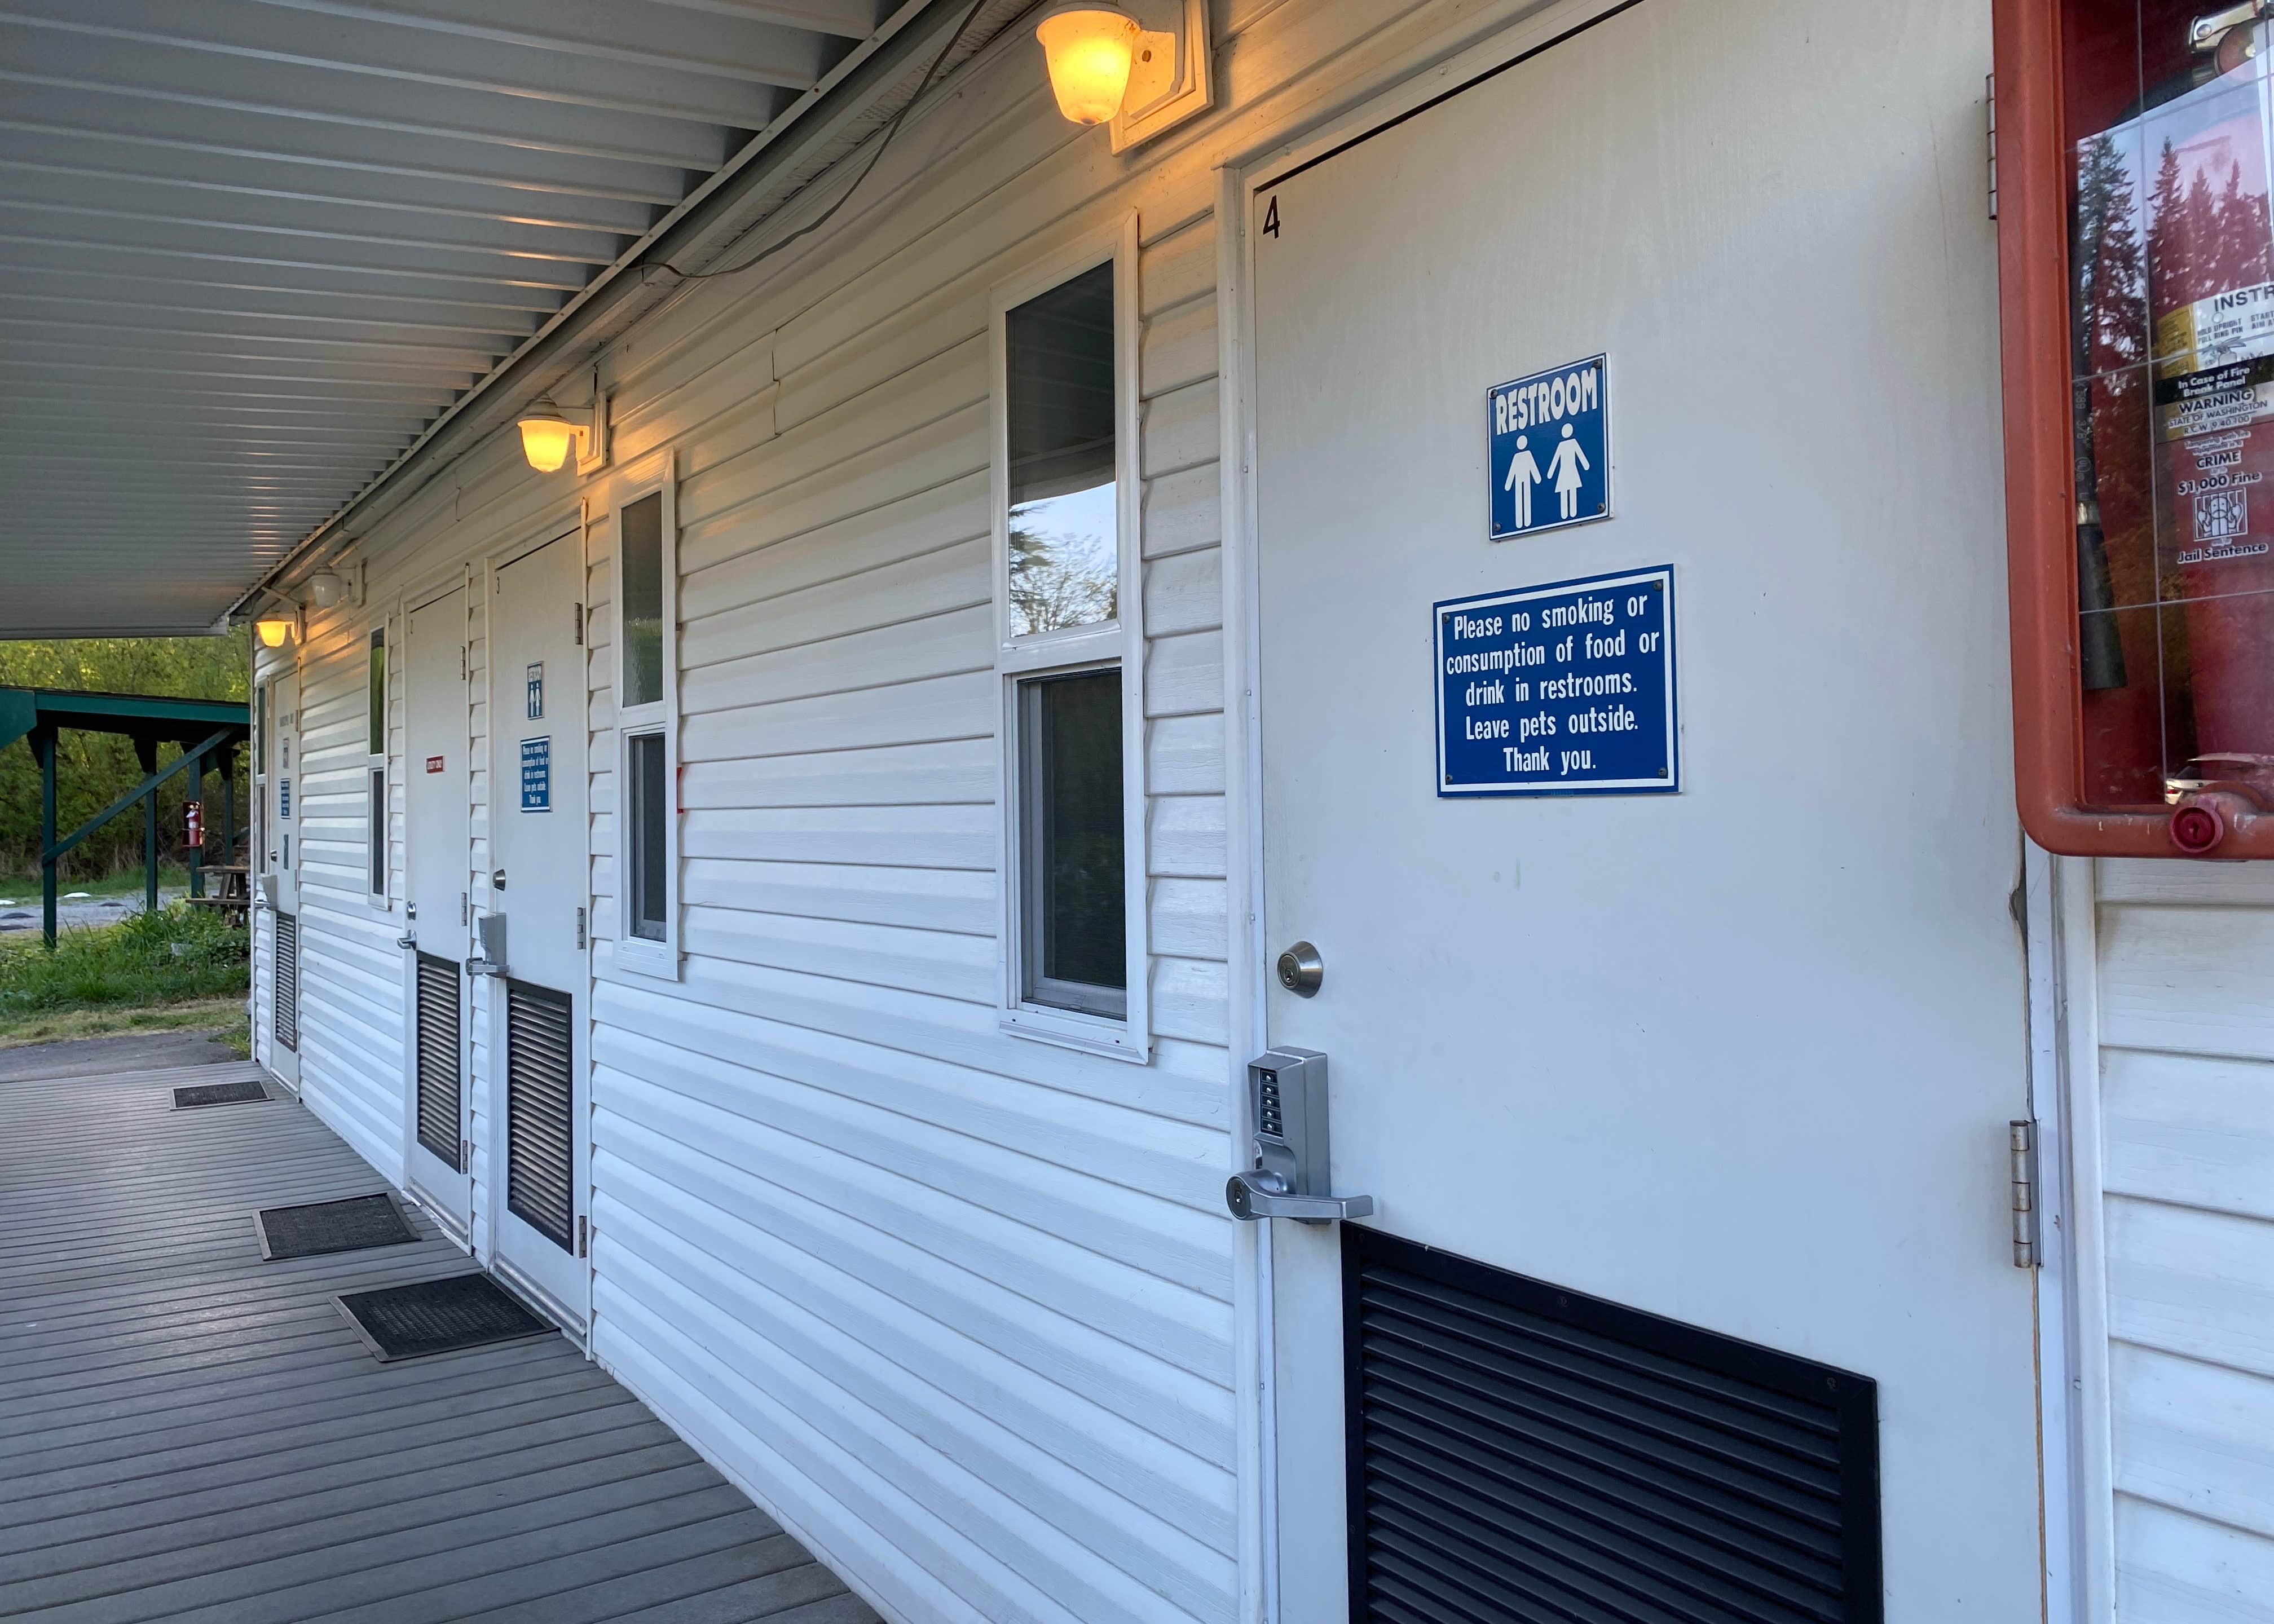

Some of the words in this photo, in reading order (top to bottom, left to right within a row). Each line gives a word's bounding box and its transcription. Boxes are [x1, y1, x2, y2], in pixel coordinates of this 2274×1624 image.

[1263, 195, 1280, 239] 4
[2214, 285, 2274, 311] INSTR
[2232, 326, 2243, 334] PIN
[2178, 381, 2188, 389] In
[2190, 375, 2215, 386] Case
[2217, 370, 2228, 380] of
[2231, 367, 2250, 377] Fire
[2183, 385, 2214, 397] Break
[2216, 376, 2246, 390] Panel
[1496, 367, 1597, 435] RESTROOM
[2170, 416, 2192, 427] STATE
[2206, 400, 2268, 419] WASHINGTON
[2179, 388, 2254, 414] WARNING
[2197, 451, 2240, 468] CRIME
[2179, 475, 2227, 493] $1,000
[2232, 472, 2260, 484] Fine
[2179, 550, 2200, 562] Jail
[2205, 544, 2266, 558] Sentence
[1455, 615, 1502, 640] Please
[1512, 612, 1530, 632] no
[1542, 596, 1614, 628] smoking
[1627, 595, 1647, 617] or
[1447, 642, 1545, 675] consumption
[1556, 636, 1574, 663] of
[1585, 629, 1625, 659] food
[1639, 631, 1659, 654] or
[1466, 679, 1504, 707] drink
[1515, 677, 1529, 702] in
[1540, 672, 1637, 700] restrooms.
[1466, 716, 1509, 740] Leave
[1521, 711, 1556, 743] pets
[1568, 704, 1638, 734] outside.
[1503, 745, 1549, 772] Thank
[1561, 749, 1596, 775] you.
